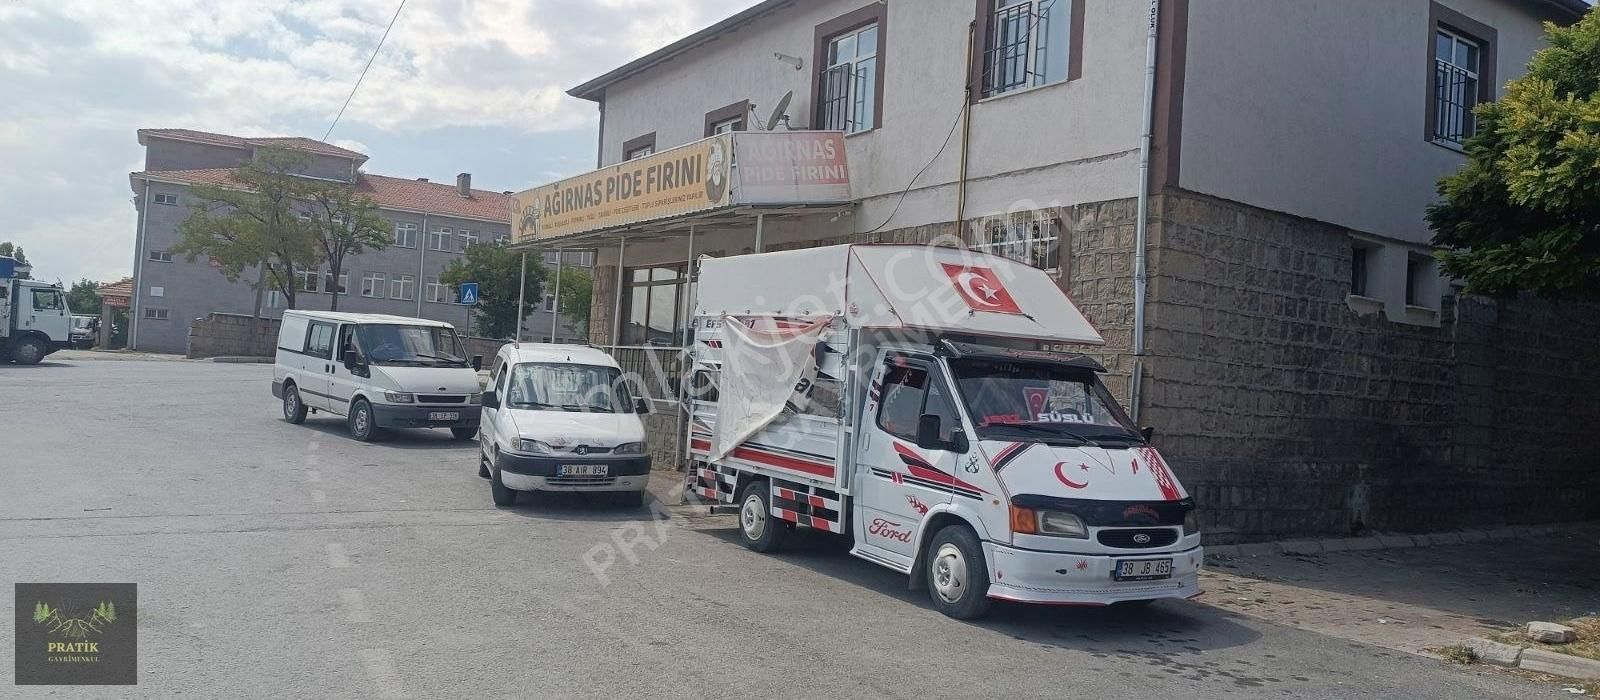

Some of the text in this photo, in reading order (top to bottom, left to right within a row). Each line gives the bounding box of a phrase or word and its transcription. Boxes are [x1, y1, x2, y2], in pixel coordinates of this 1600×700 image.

[791, 164, 845, 181] FIRINI
[544, 154, 702, 218] AĞIRNAS PİDE FIRINI
[1037, 410, 1095, 424] SÜSLÜ
[562, 465, 607, 474] 38 AIR 894
[869, 518, 912, 543] Ford
[1122, 560, 1170, 575] 38 JB 465
